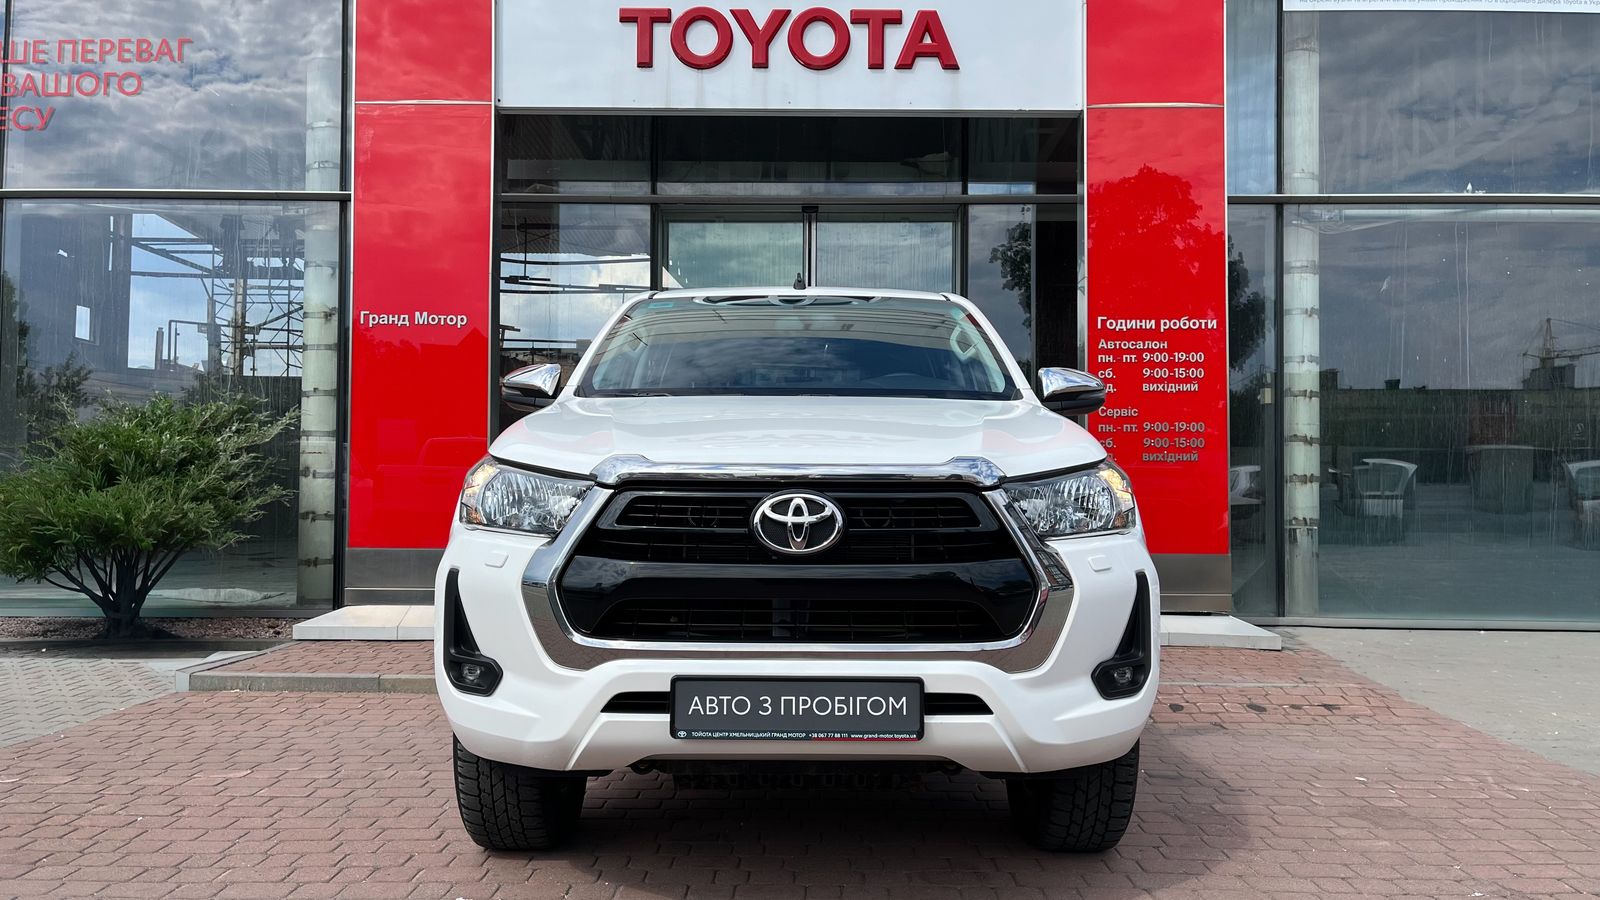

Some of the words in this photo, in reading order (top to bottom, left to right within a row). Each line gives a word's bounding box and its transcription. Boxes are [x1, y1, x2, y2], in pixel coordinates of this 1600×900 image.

[619, 6, 960, 70] TOYOTA
[57, 38, 193, 64] ПЕРЕВАГ
[1, 71, 142, 97] ВАШОГО
[360, 310, 410, 328] Гранд
[414, 311, 468, 328] Мотор
[1097, 316, 1156, 331] Години
[1160, 316, 1217, 332] роботи
[1098, 339, 1168, 349] Автосалон
[1142, 352, 1205, 363] 9:00-19:00
[1098, 368, 1116, 379] сб.
[1142, 368, 1205, 379] 9:00-15:00
[1104, 383, 1117, 393] д.
[1142, 381, 1199, 393] вихідний
[1098, 406, 1139, 419] Сервіс
[1143, 421, 1205, 432] 9:00-19:00
[1143, 437, 1205, 448] 9:00-15:00
[1142, 451, 1199, 462] вихідний
[688, 695, 751, 715] АВТО
[758, 695, 772, 715] З
[780, 695, 907, 716] ПРОБІГОМ
